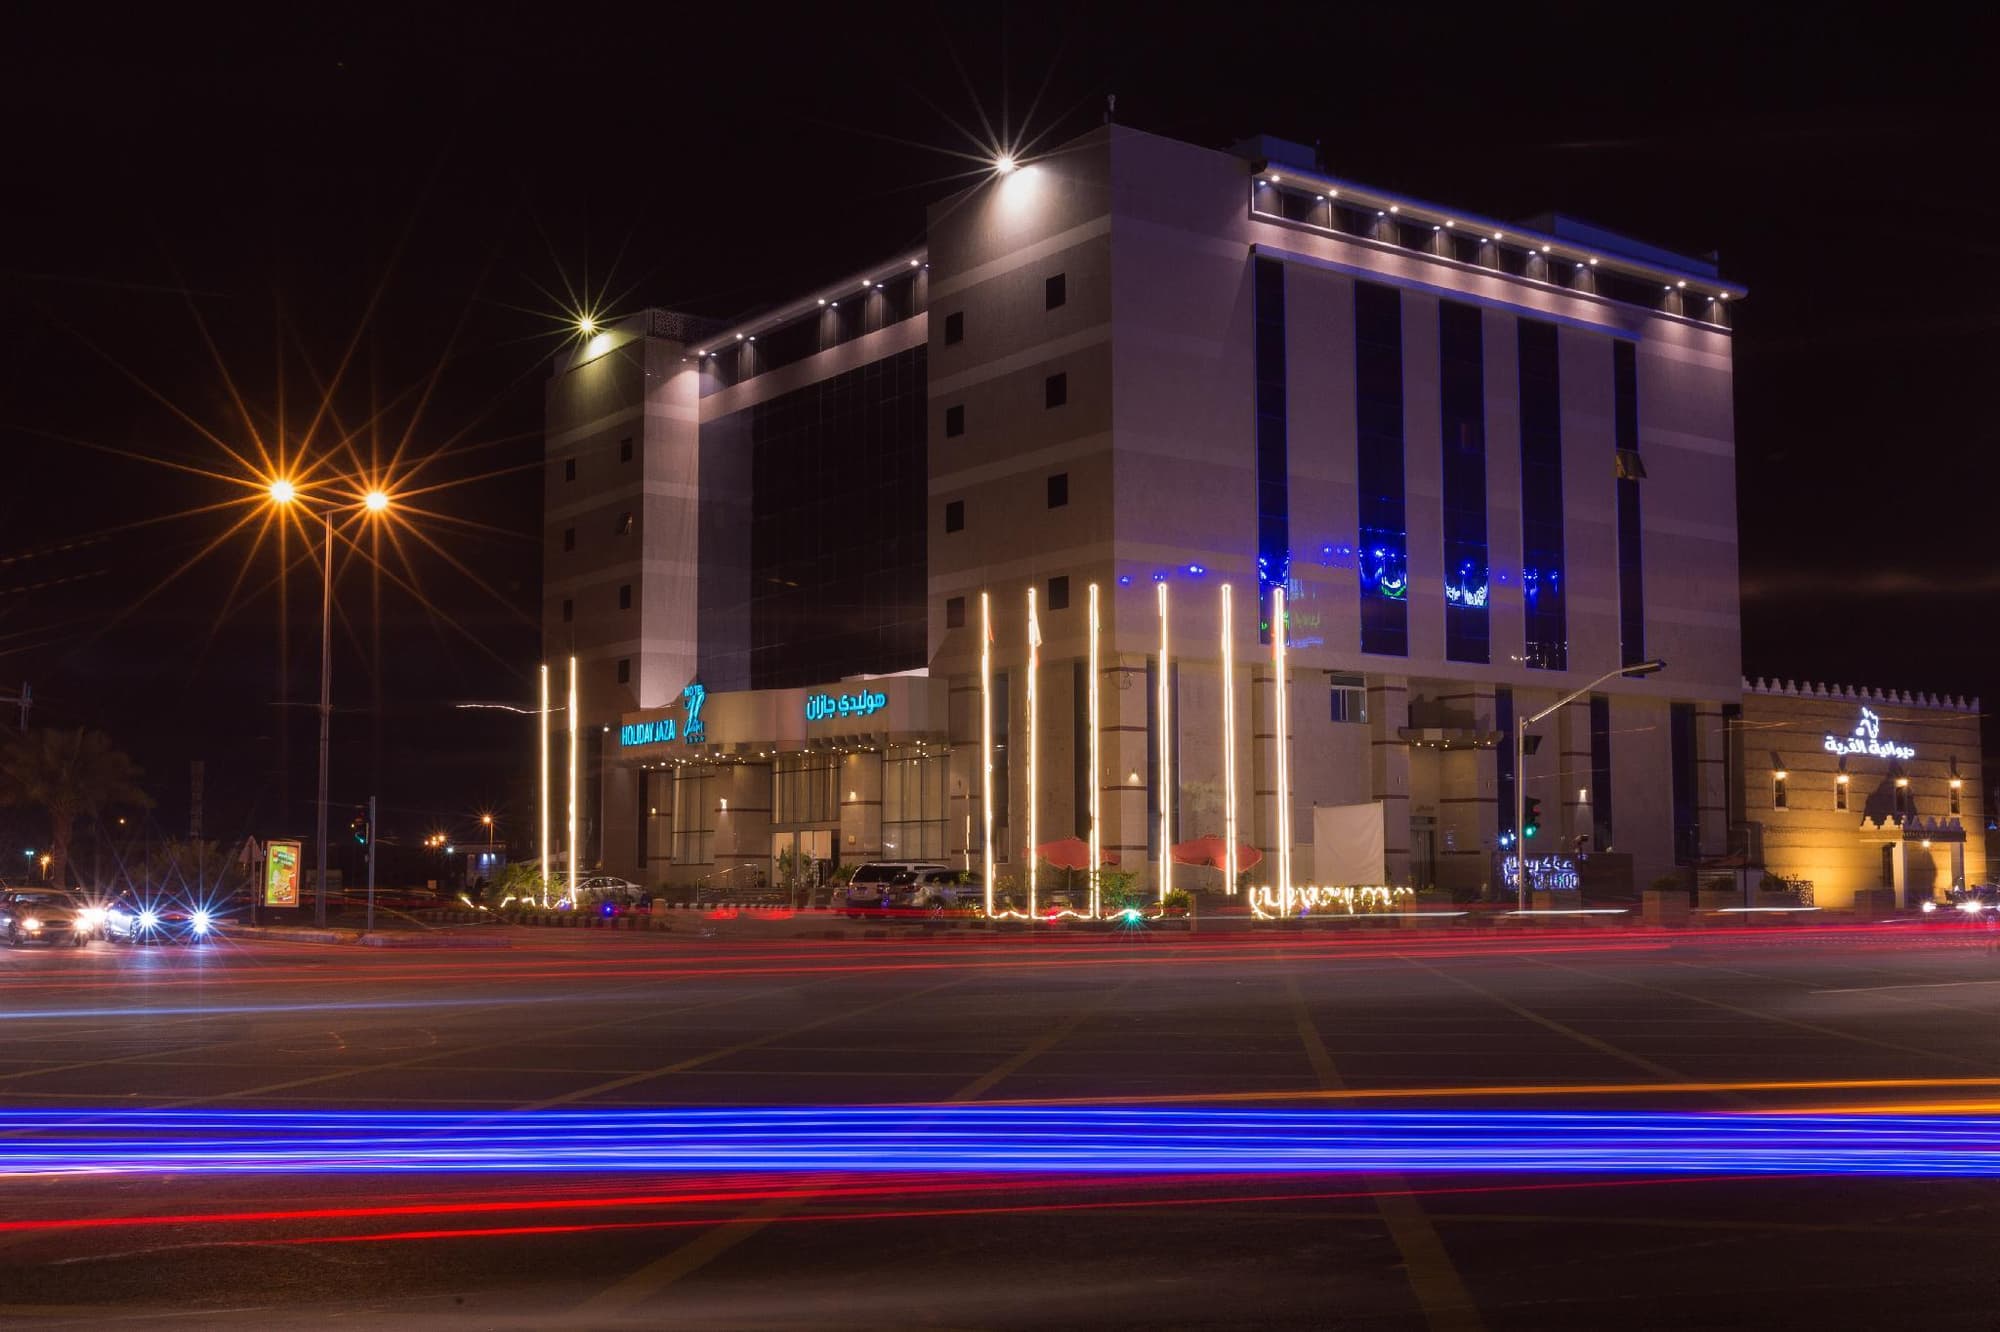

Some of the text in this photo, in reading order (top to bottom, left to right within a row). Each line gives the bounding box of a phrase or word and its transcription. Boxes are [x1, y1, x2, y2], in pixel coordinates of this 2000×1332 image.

[806, 689, 886, 720] هوليدي جازان
[621, 722, 654, 746] HOLIDAY
[654, 719, 677, 742] JAZA
